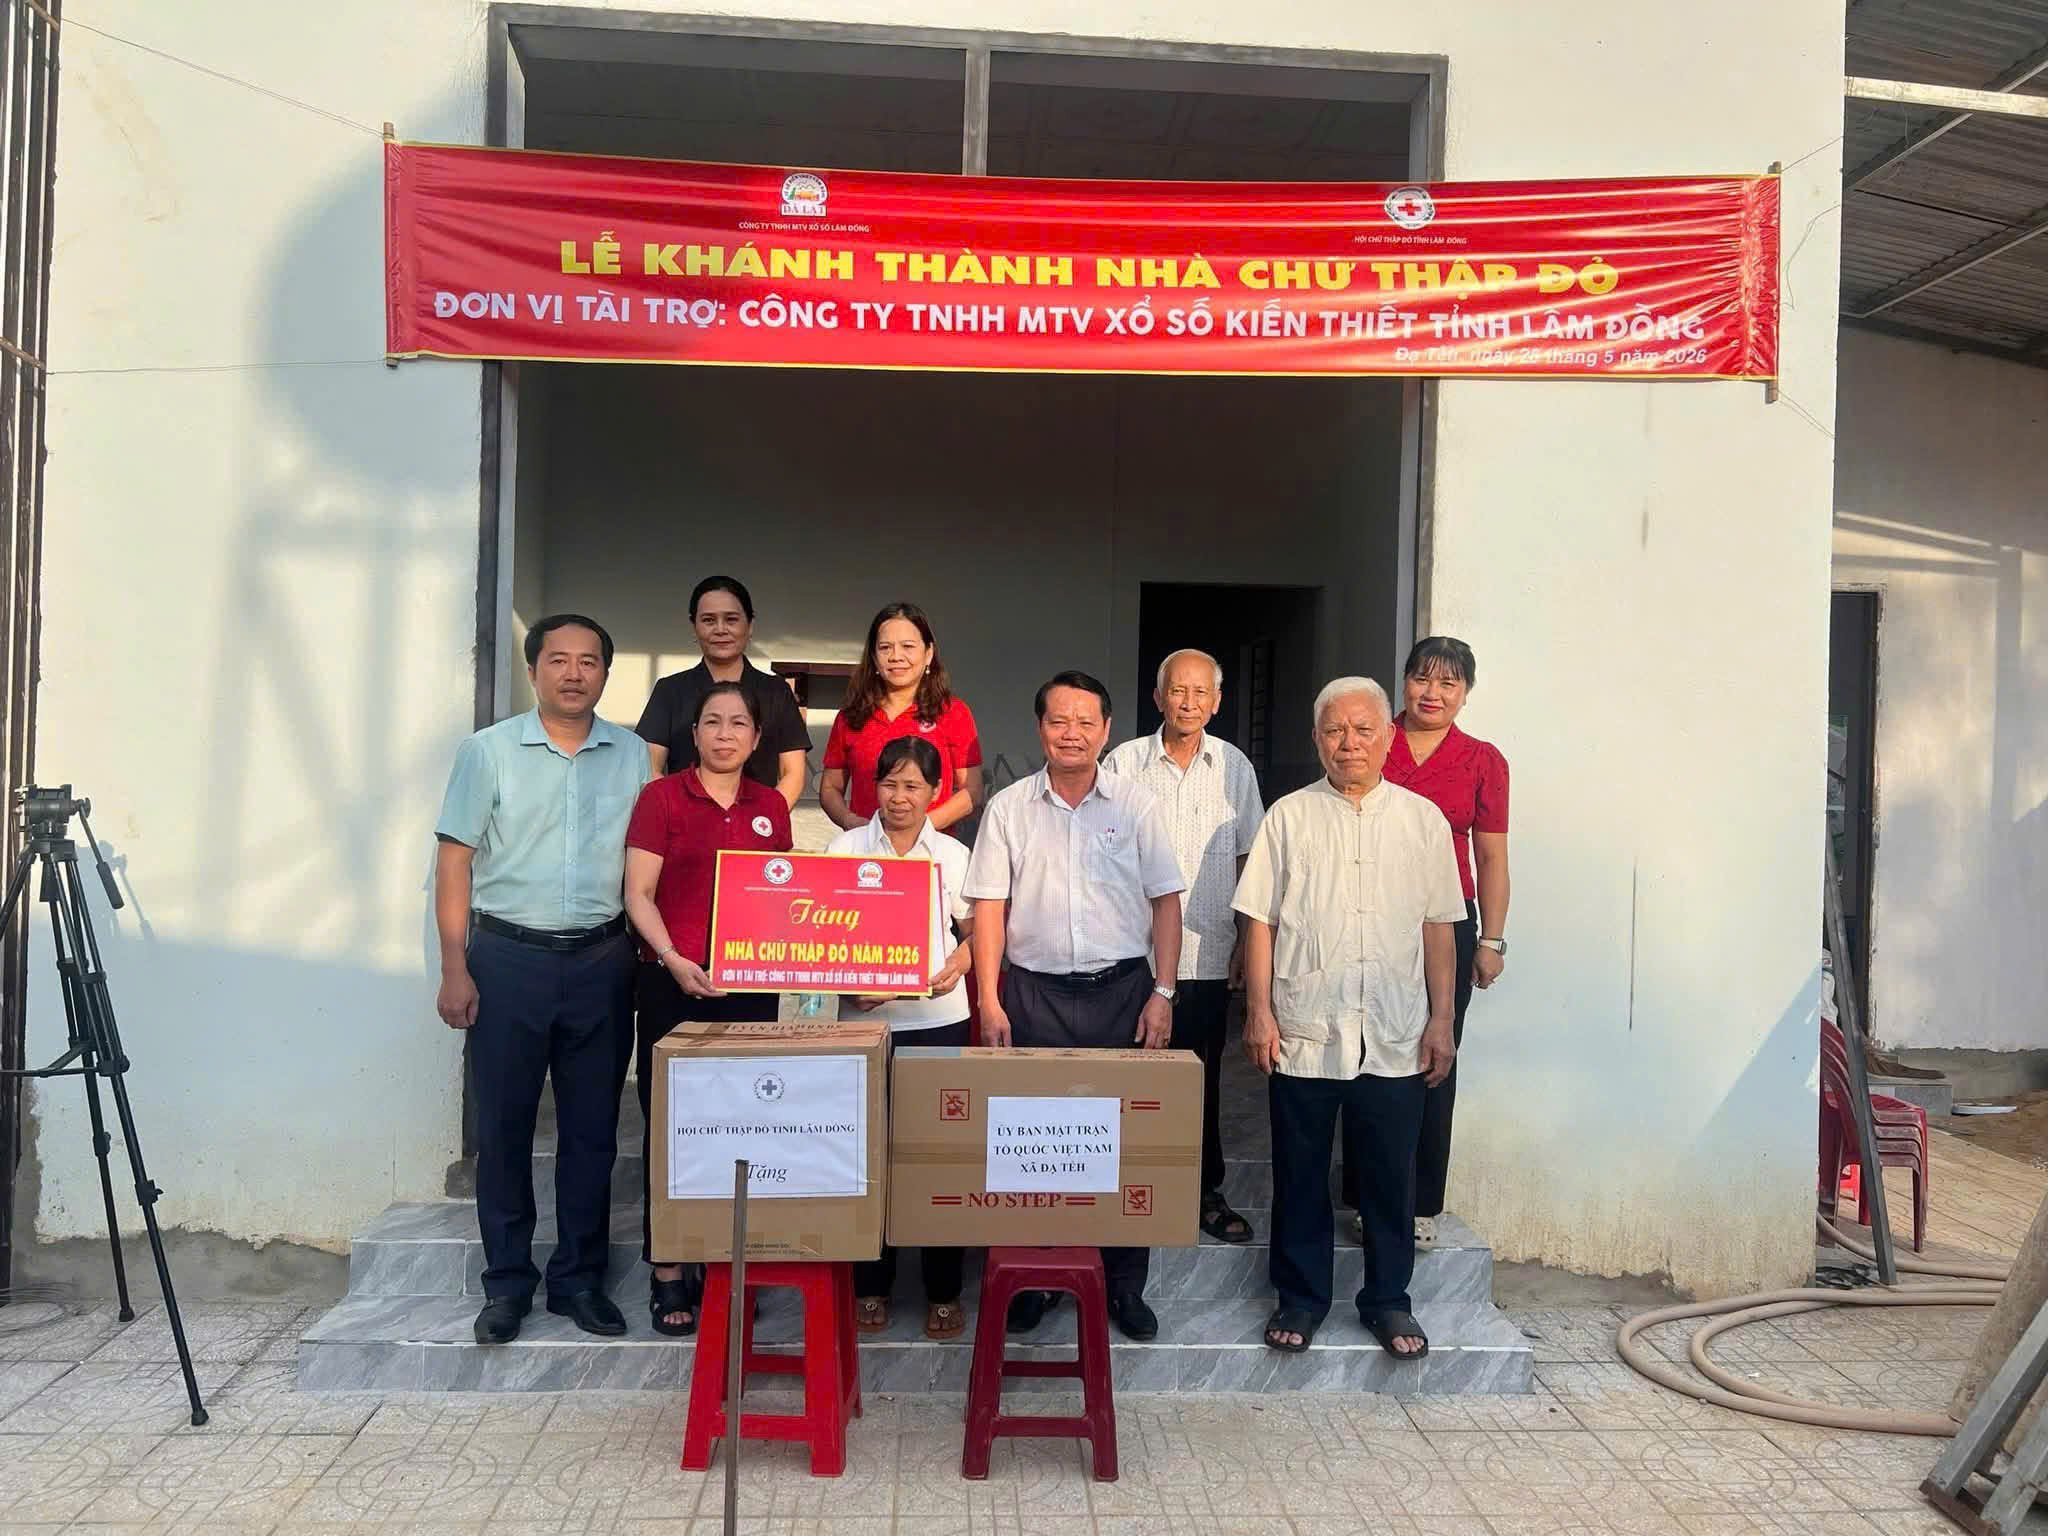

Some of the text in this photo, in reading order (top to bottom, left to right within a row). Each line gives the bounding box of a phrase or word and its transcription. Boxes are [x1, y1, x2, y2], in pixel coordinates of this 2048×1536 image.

[739, 222, 760, 230] CÔNG
[770, 223, 791, 231] TNHH
[560, 231, 1619, 301] LỄ KHÁNH THÀNH NHÀ CHỮ THẬP ĐỎ
[434, 289, 1705, 341] ĐƠN VỊ TÀI TRỢ: CÔNG TY TNHH MTV XỔ SỐ KIẾN THIẾT TỈNH LÂM ĐỒNG
[1547, 348, 1598, 367] tháng
[1603, 350, 1614, 364] 5
[1620, 349, 1659, 363] năm
[1664, 349, 1708, 364] 2026
[788, 898, 860, 932] Tặng
[724, 937, 919, 968] NHÀ CHỮ THẬP ĐỎ NĂM 2026
[677, 1127, 697, 1137] HỘI
[699, 1124, 721, 1136] CHỮ
[725, 1125, 752, 1137] THẬP
[755, 1123, 770, 1135] ĐỎ
[800, 1123, 823, 1134] LÂM
[825, 1122, 855, 1134] ĐỒNG
[1018, 1126, 1042, 1137] BAN
[1074, 1124, 1109, 1137] TRẬN
[993, 1142, 1113, 1157] TỔ QUỐC VIỆT NAM
[745, 1163, 788, 1183] Tặng
[1020, 1161, 1037, 1173] XÃ
[1041, 1163, 1057, 1175] ĐẠ
[967, 1192, 1062, 1208] NO STEP
